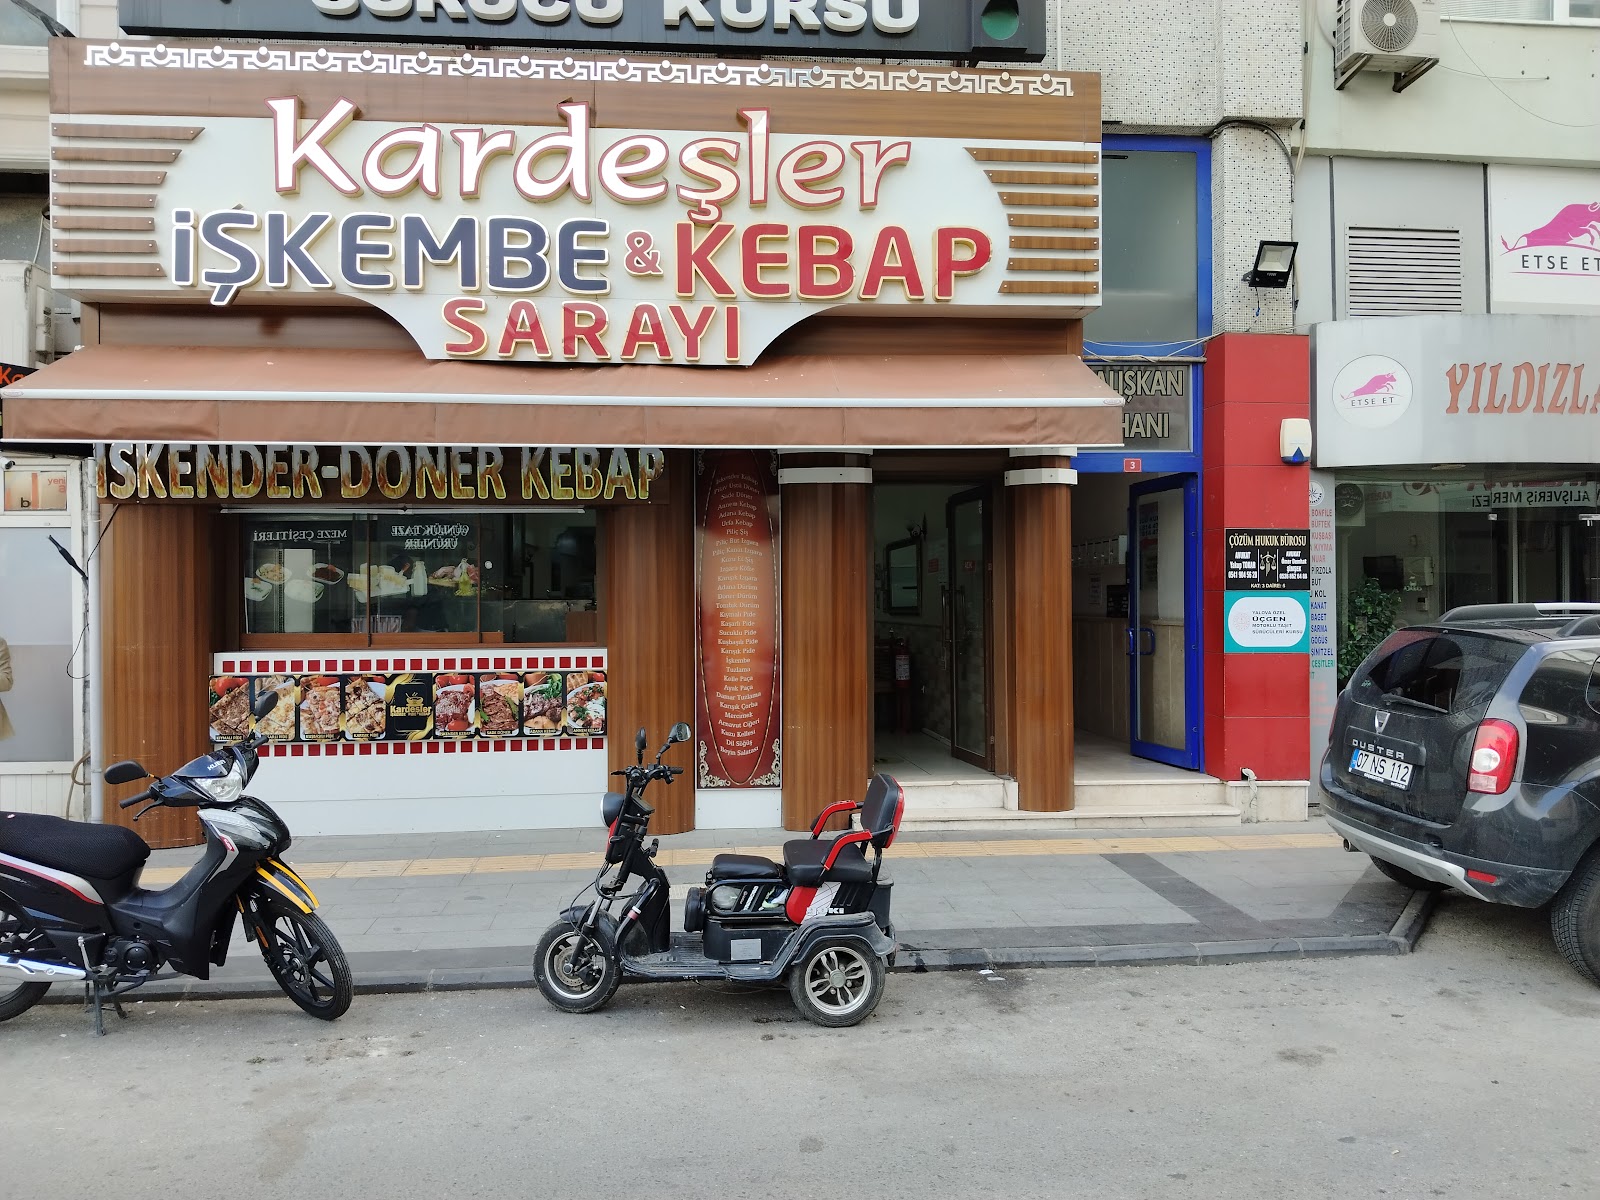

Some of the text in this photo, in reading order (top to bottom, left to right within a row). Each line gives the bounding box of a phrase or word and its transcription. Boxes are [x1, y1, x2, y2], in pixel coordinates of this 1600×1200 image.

[265, 95, 912, 225] Kardeşler
[170, 207, 994, 306] İŞKEMBE & KEBAP
[1521, 255, 1568, 270] ETSE
[441, 297, 741, 363] SARAYI
[1446, 361, 1600, 415] YILDIZL
[1351, 398, 1376, 407] ETSE
[1130, 461, 1137, 470] 3
[520, 446, 665, 500] KEBAP
[739, 501, 757, 511] Kebap
[738, 510, 756, 520] Kebap
[735, 518, 754, 528] Kebap
[1228, 533, 1307, 549] ÇÖZÜM HUKUK BÜROSU
[1311, 555, 1326, 563] NUAR
[1311, 578, 1322, 586] BUT
[1314, 590, 1327, 598] KOL
[1310, 601, 1327, 610] KANAT
[1252, 615, 1286, 623] ÜÇGEN
[1310, 613, 1327, 621] BAGET
[1310, 624, 1328, 633] SARMA
[726, 739, 735, 747] Dil
[1352, 738, 1405, 760] DUSTER
[1356, 752, 1370, 769] 07
[1369, 756, 1387, 775] NS
[1390, 762, 1410, 783] 112
